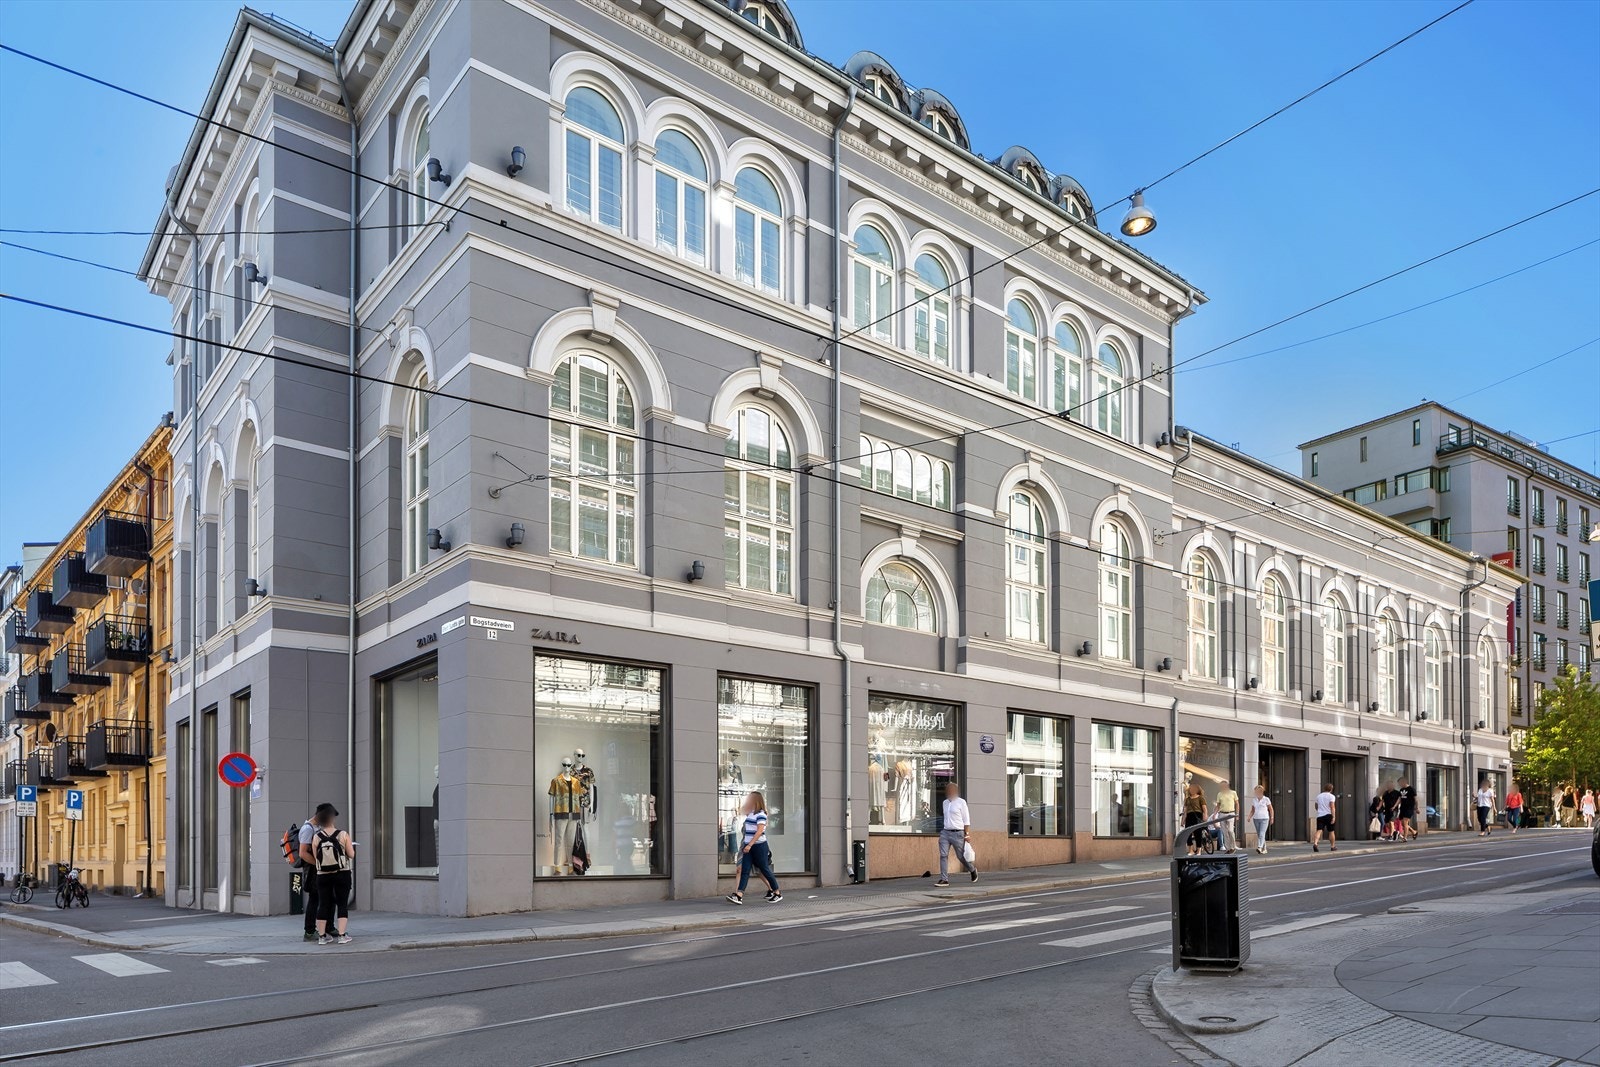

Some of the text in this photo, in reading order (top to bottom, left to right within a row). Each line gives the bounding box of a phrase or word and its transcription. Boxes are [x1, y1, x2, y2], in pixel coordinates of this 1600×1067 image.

[472, 617, 513, 630] Bogstadveien
[489, 630, 496, 639] 12
[531, 628, 581, 645] ZARA
[1258, 732, 1274, 740] ZARA
[21, 787, 32, 800] P
[70, 792, 79, 807] P
